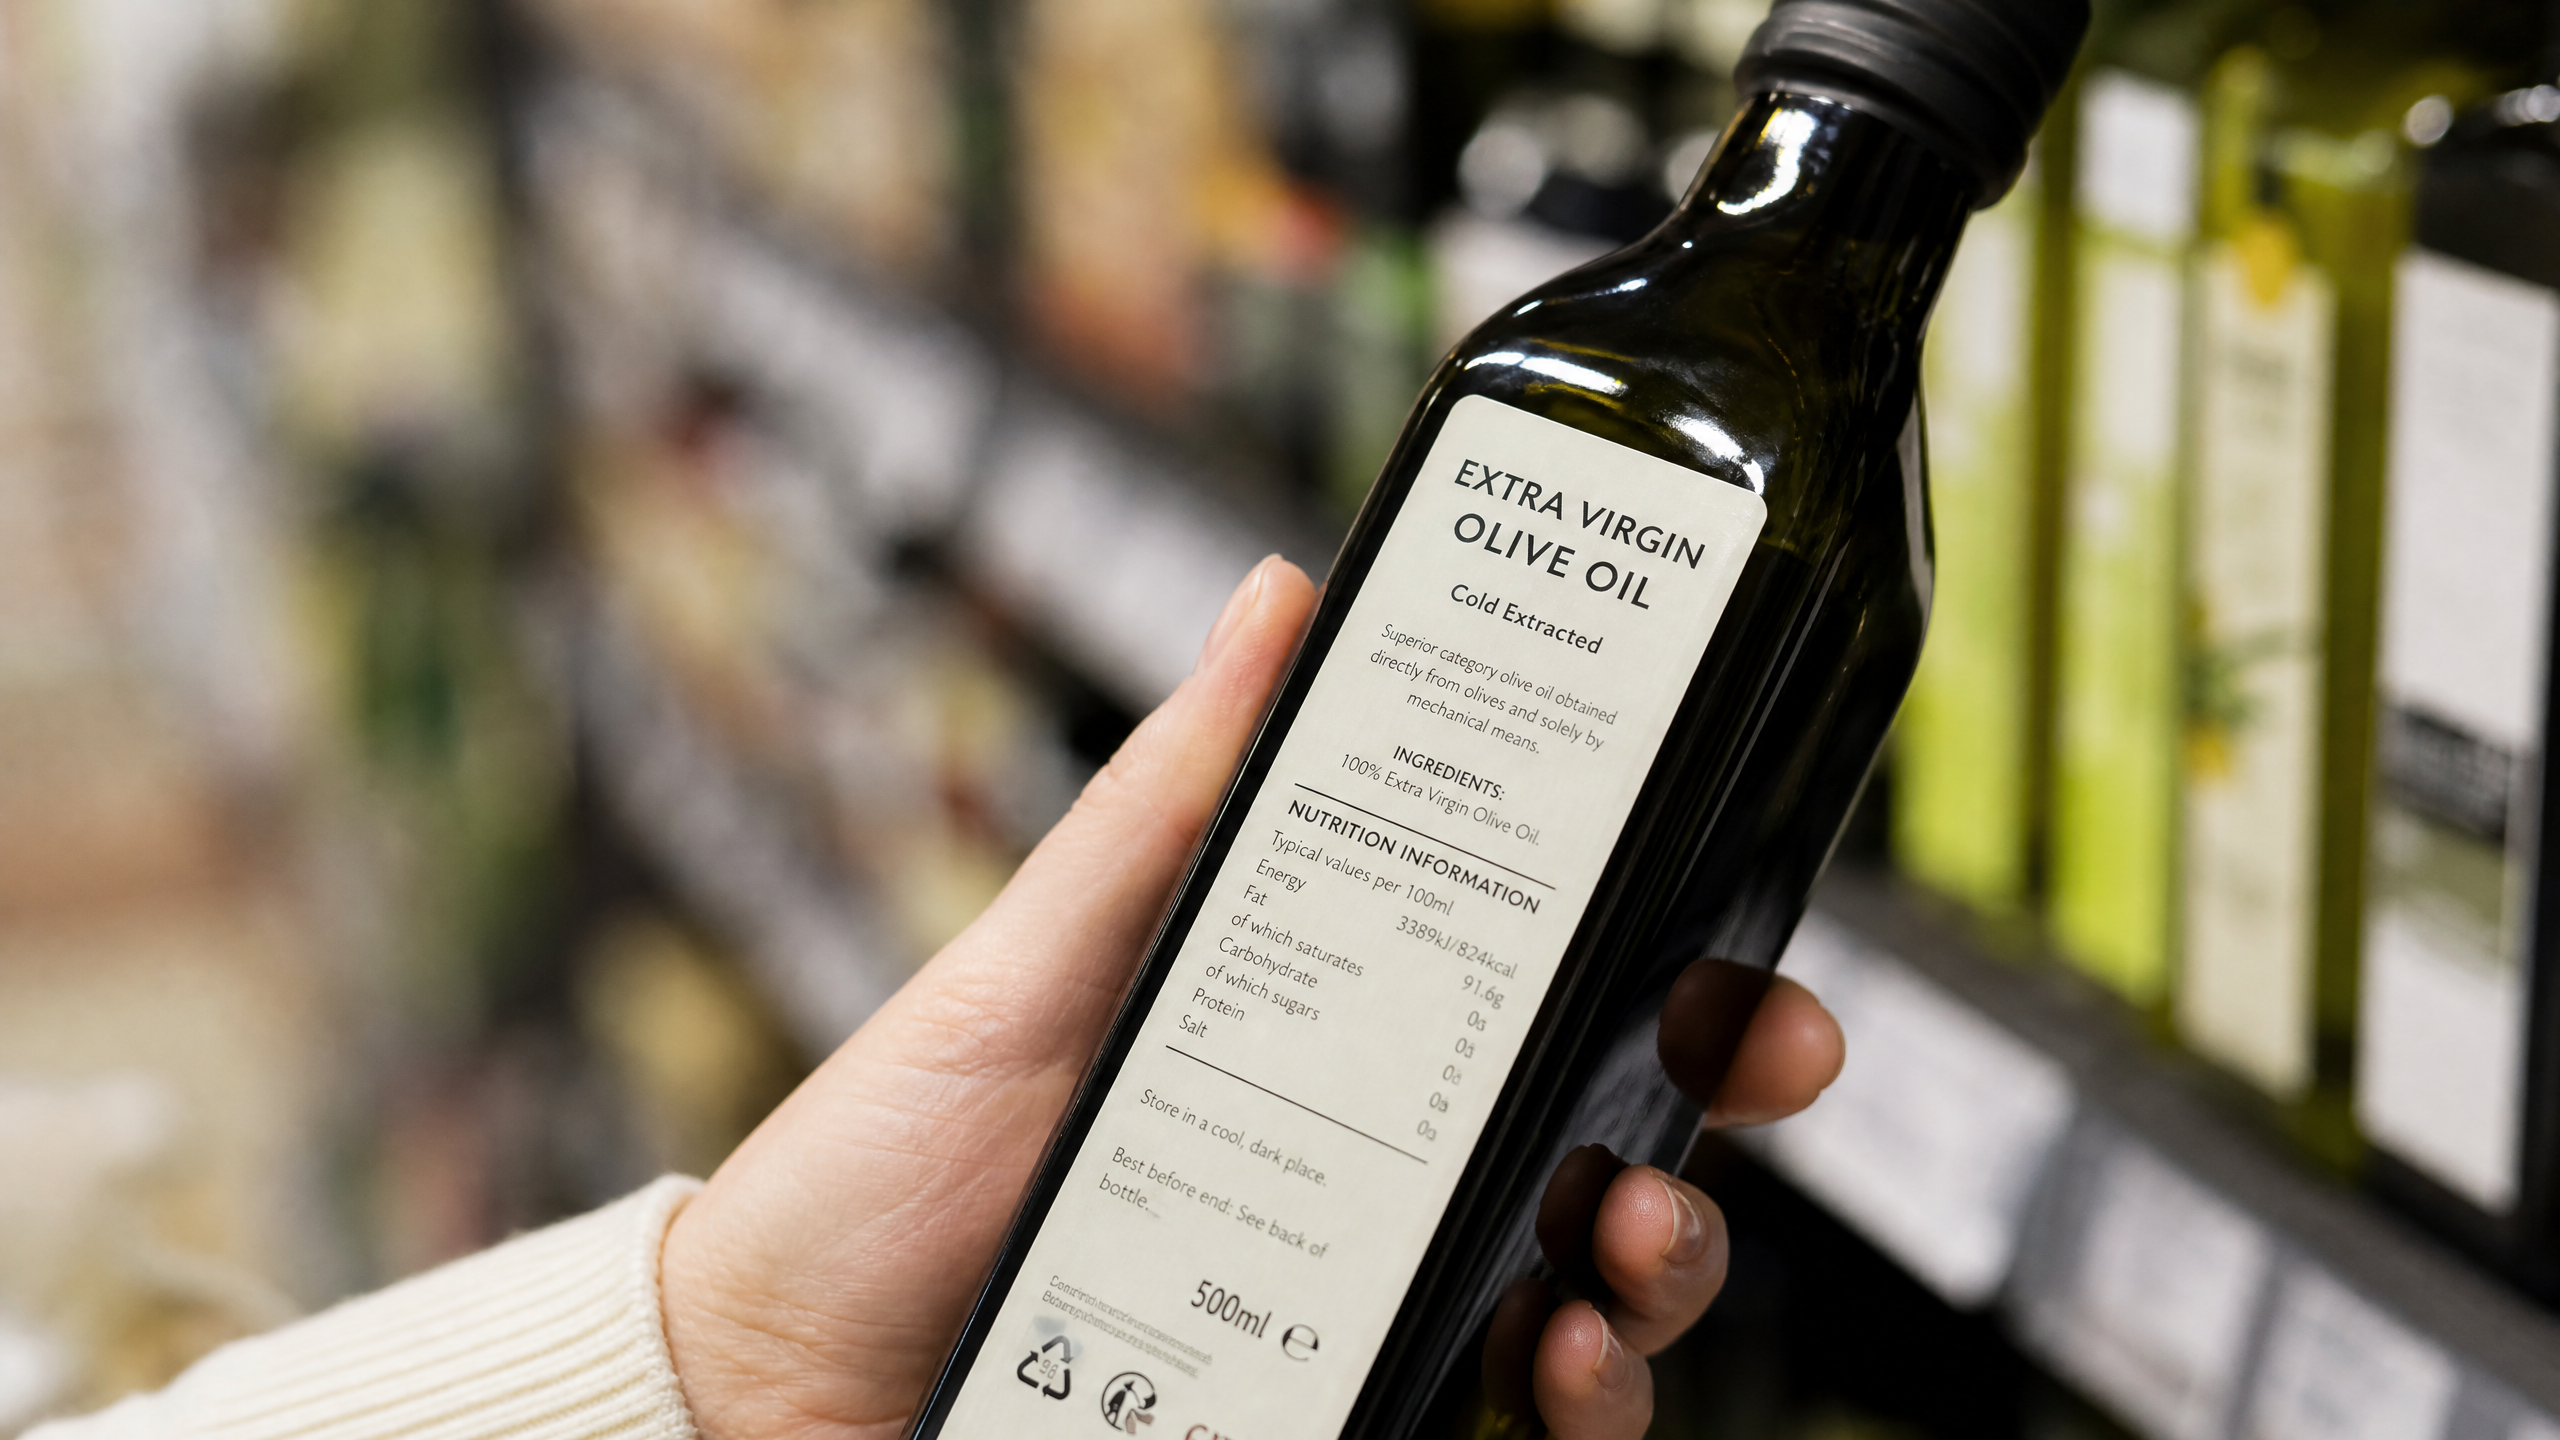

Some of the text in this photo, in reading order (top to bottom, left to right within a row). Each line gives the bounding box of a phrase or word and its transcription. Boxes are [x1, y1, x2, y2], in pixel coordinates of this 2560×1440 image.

[1453, 457, 1706, 570] EXTRA VIRGIN
[1452, 512, 1650, 610] OLIVE OIL
[1449, 583, 1604, 655] Cold Extracted
[1369, 648, 1605, 752] directly from olives and solely by
[1380, 622, 1619, 725] Superior category olive oil obtained
[1405, 693, 1540, 754] mechanical means.
[1340, 753, 1540, 846] 100% Extra Virgin Olive Oil.
[1391, 744, 1505, 801] INGREDIENTS:
[1255, 857, 1307, 893] Energy
[1271, 828, 1455, 916] Typical values per 100ml
[1286, 798, 1541, 915] NUTRITION INFORMATION
[1242, 883, 1268, 906] Fat
[1218, 935, 1318, 988] Carbohydrate
[1230, 912, 1364, 977] of which saturates
[1191, 986, 1245, 1021] Protein
[1204, 963, 1320, 1021] of which sugars
[1461, 974, 1505, 1010] 91.6g
[1177, 1013, 1208, 1038] Salt
[1139, 1087, 1326, 1186] Store in a cool, dark place.
[1098, 1171, 1149, 1211] bottle.
[1111, 1145, 1329, 1258] Best before end: See back of
[1189, 1278, 1273, 1340] 500ml
